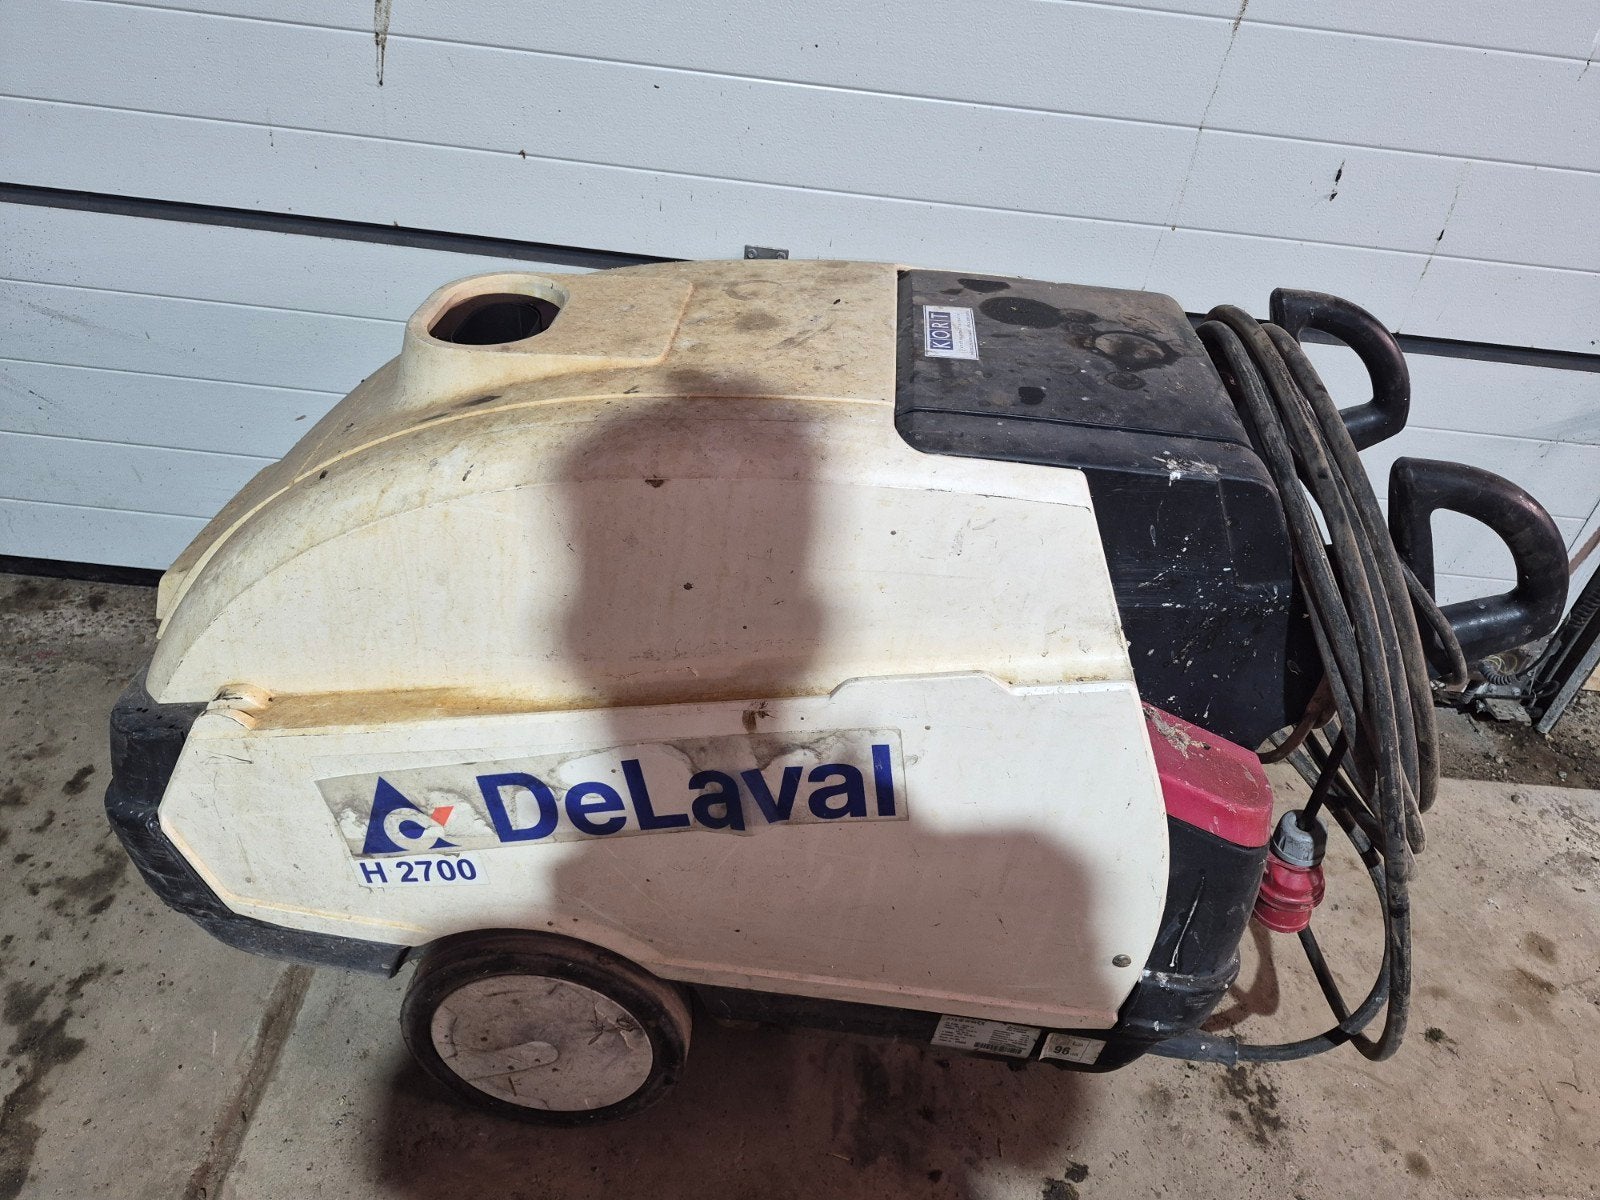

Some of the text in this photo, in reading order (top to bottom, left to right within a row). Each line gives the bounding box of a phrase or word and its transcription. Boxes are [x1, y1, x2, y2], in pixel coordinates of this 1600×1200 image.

[930, 312, 952, 349] KORT
[476, 744, 896, 843] DeLaval
[359, 857, 478, 884] H 2700
[1053, 1045, 1071, 1056] 96
